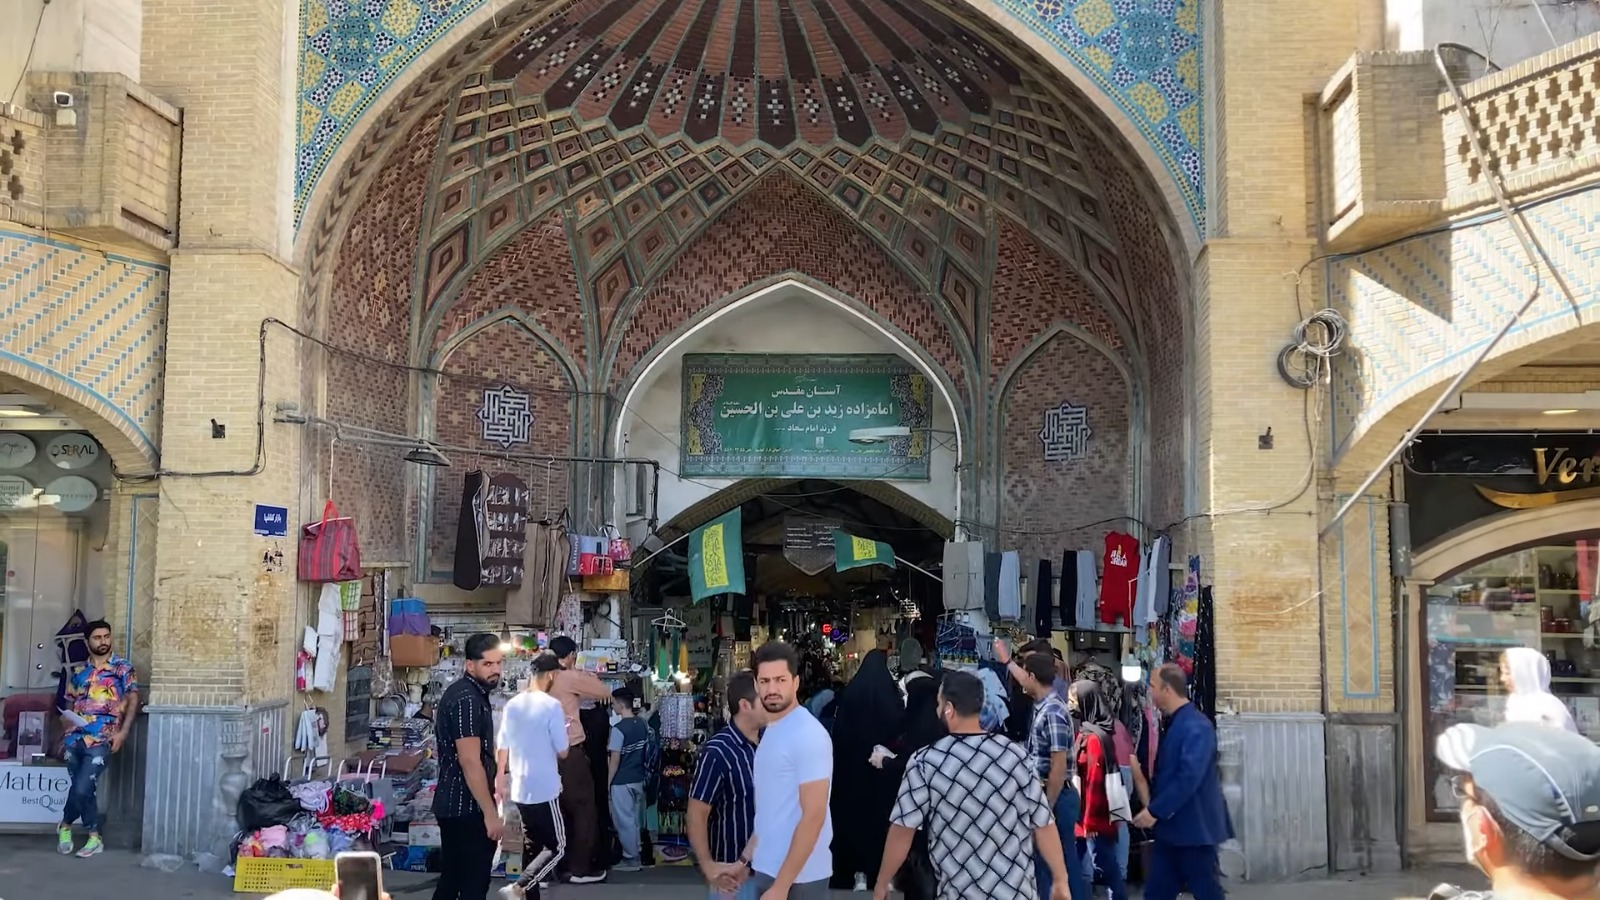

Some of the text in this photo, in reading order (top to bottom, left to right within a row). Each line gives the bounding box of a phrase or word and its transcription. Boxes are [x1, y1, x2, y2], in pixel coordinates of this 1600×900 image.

[771, 384, 841, 398] آستان مقدس
[720, 401, 893, 419] امامزاده زید بن علی بن الحسین
[805, 423, 819, 434] امام
[819, 423, 837, 434] فرزند
[61, 444, 95, 458] SERAL
